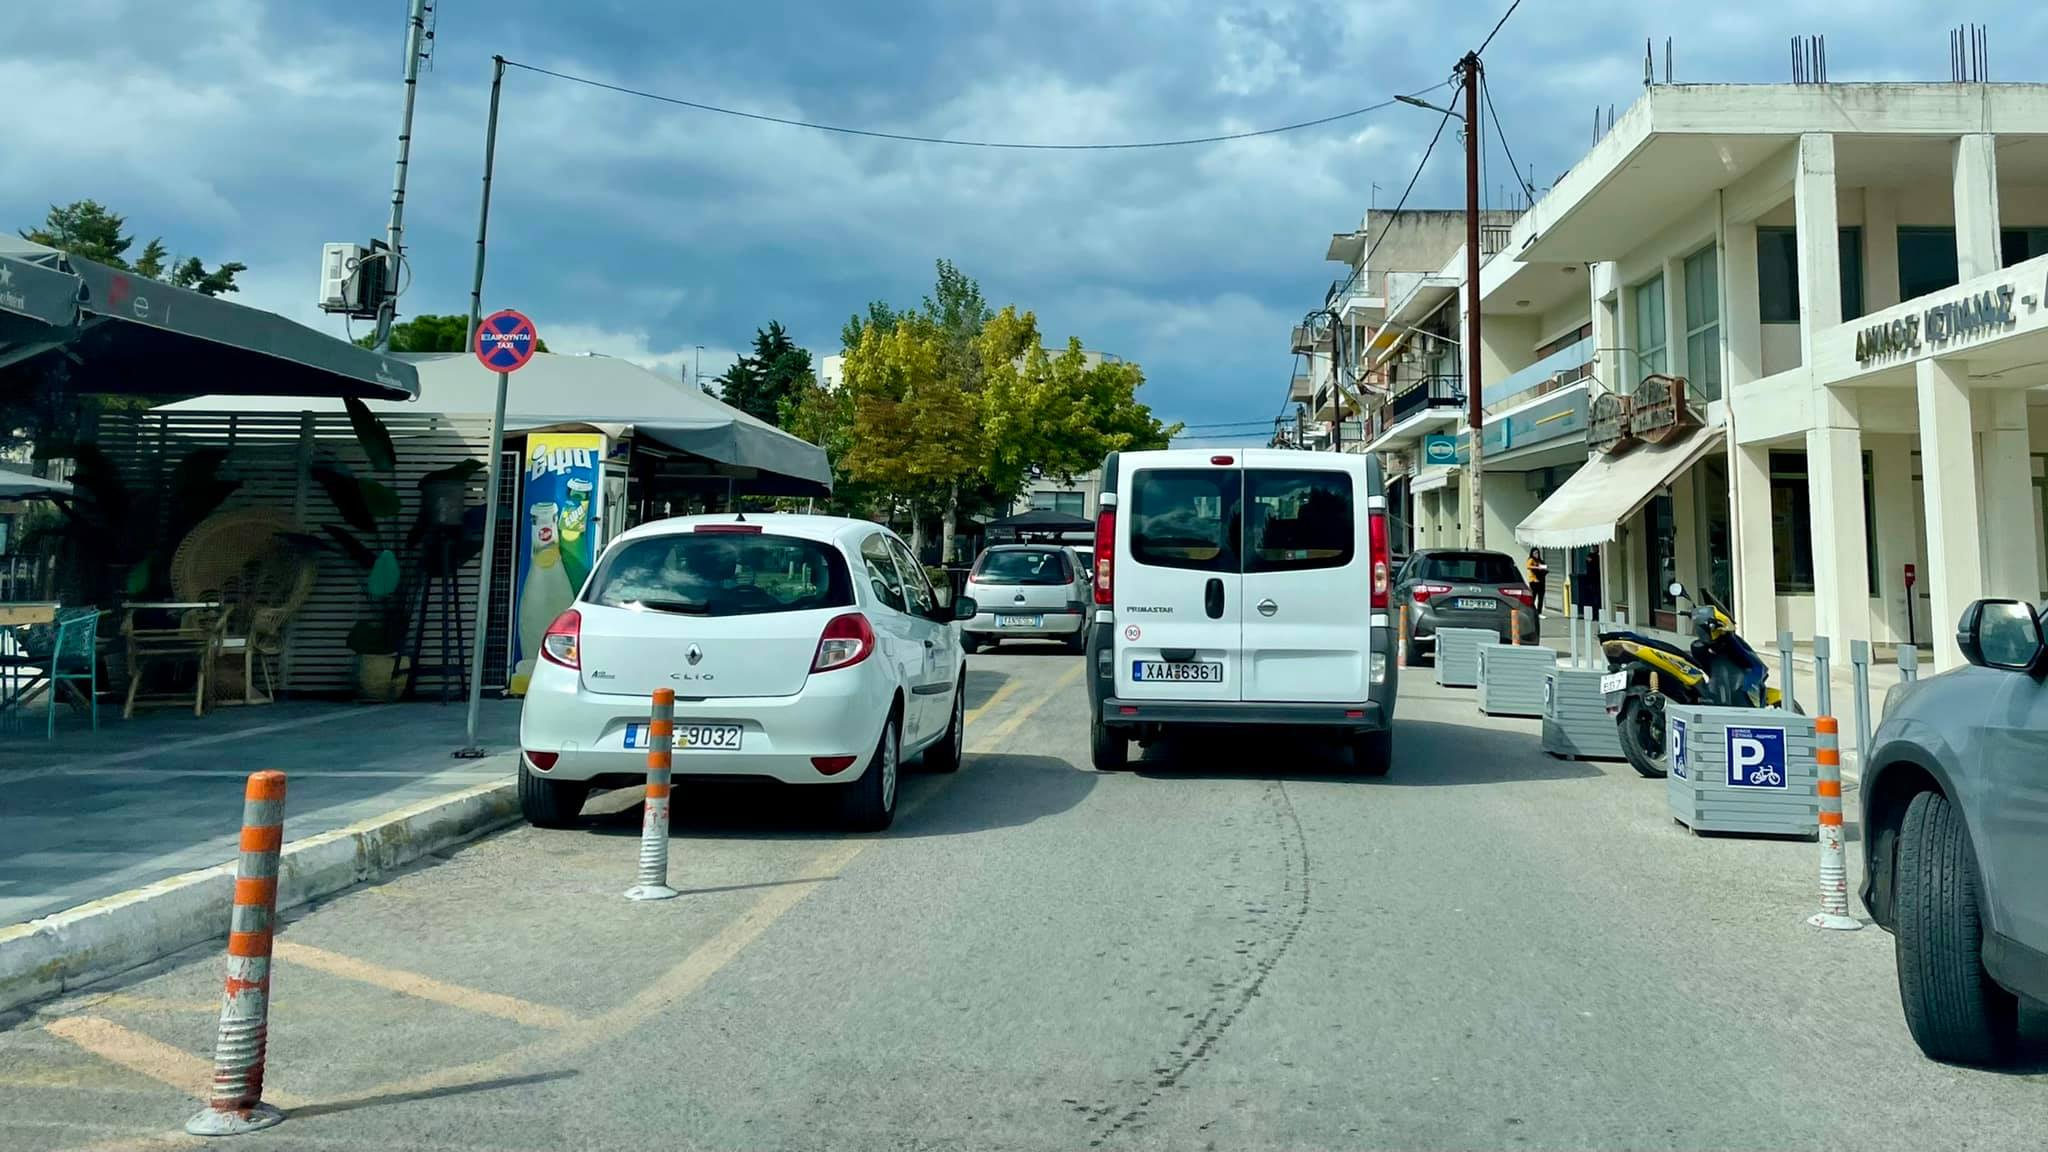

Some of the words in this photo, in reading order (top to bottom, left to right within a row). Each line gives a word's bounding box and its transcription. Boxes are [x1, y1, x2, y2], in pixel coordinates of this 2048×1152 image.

[669, 672, 715, 681] CLIO
[1672, 729, 1681, 769] P
[1731, 738, 1765, 781] P
